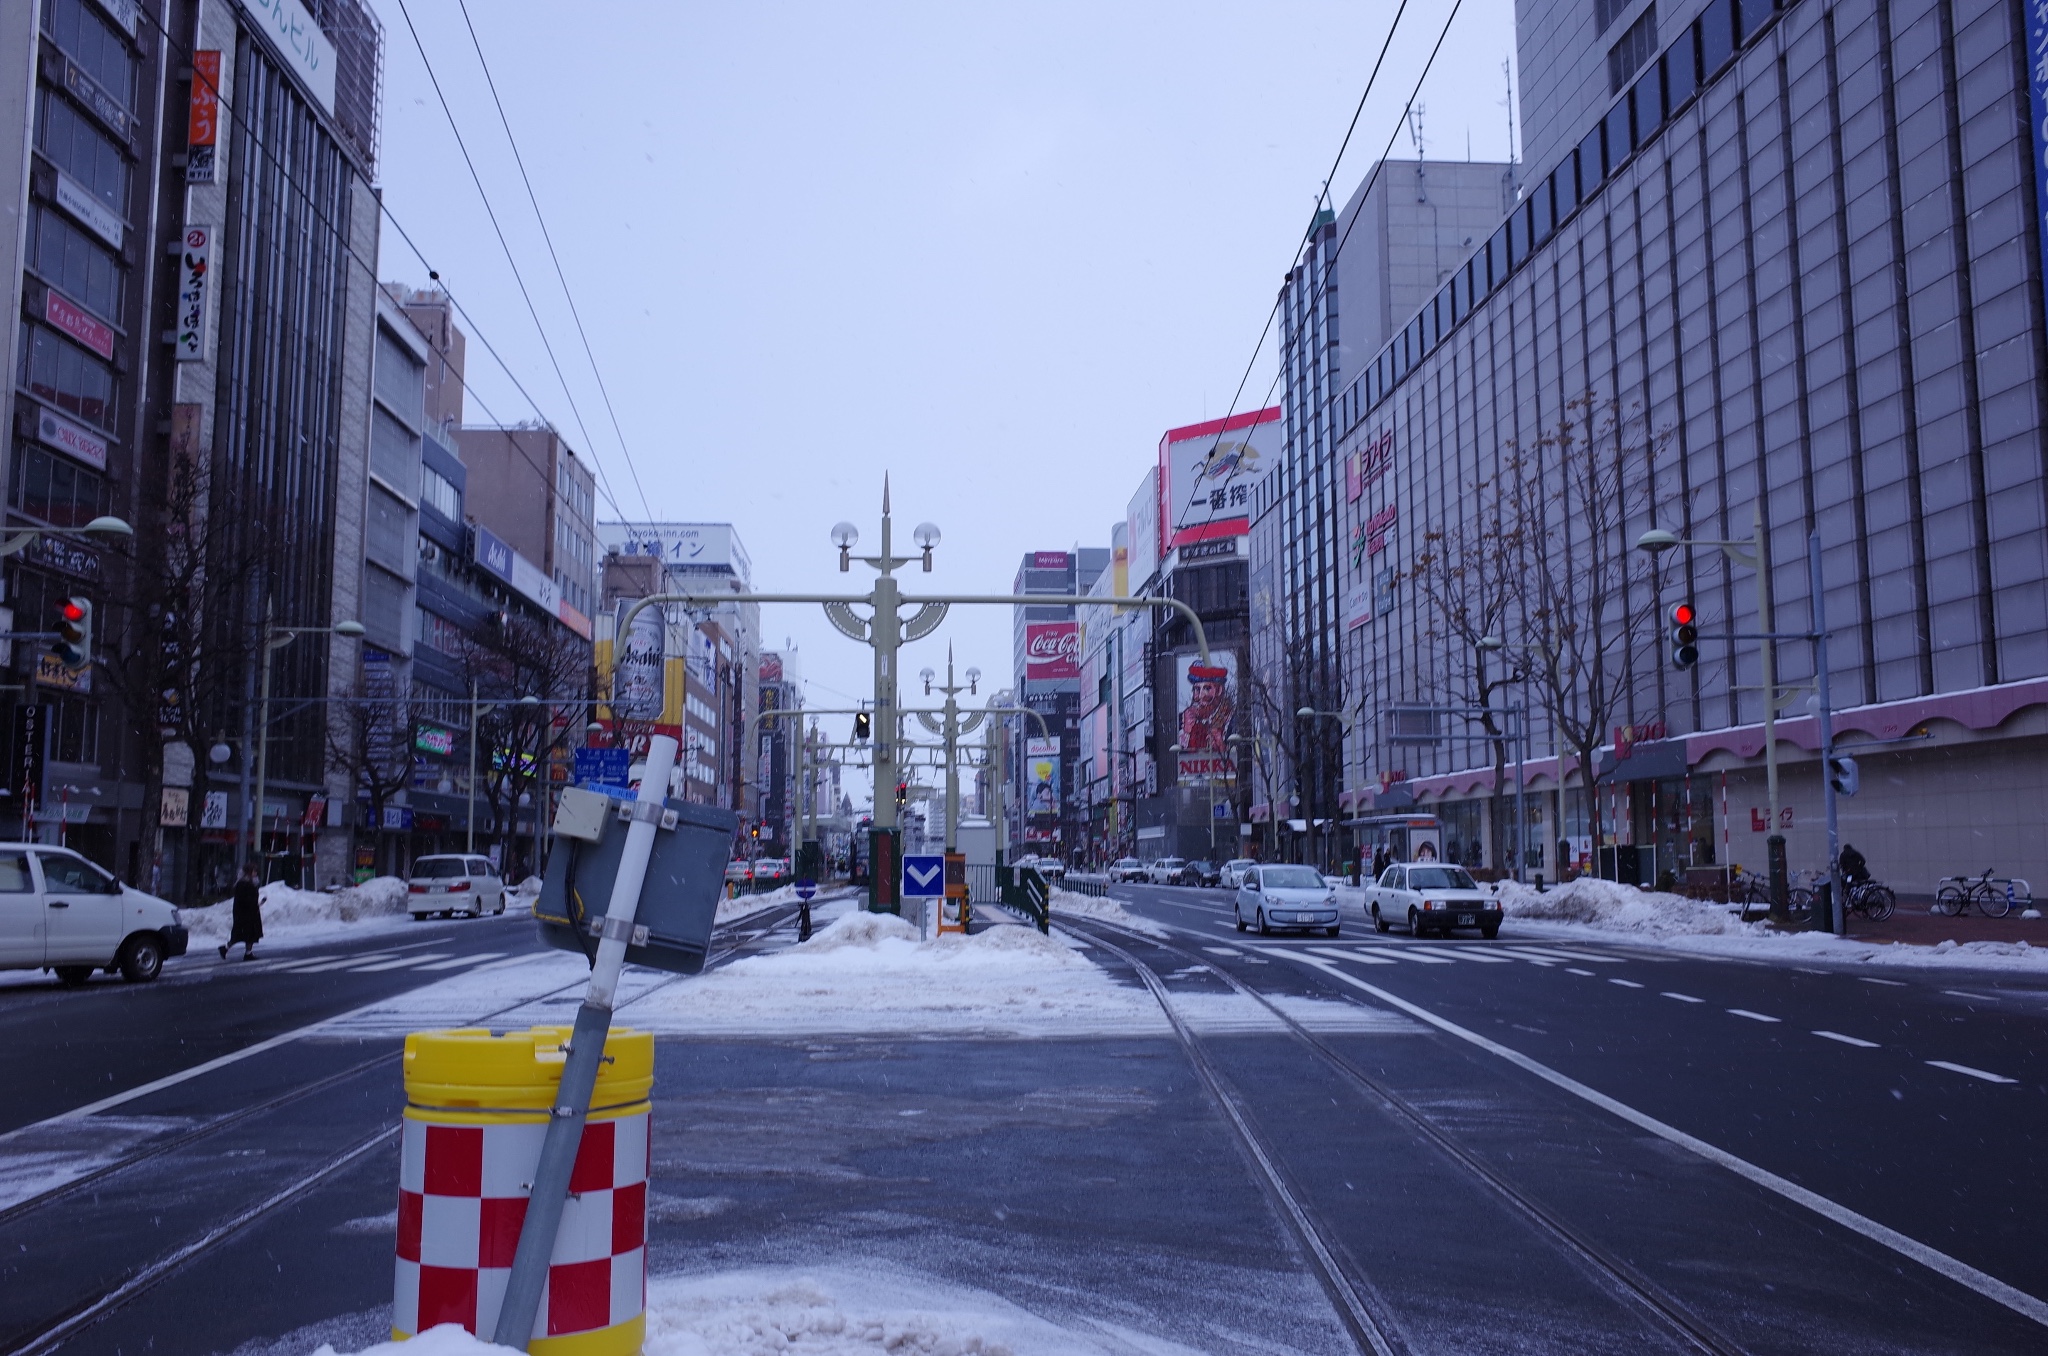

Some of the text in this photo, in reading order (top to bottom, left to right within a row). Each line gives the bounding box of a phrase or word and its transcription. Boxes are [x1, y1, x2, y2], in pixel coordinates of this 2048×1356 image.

[260, 0, 319, 71] んビル
[1362, 428, 1391, 475] ラフィラ
[1191, 483, 1254, 510] 一番搾
[1181, 541, 1236, 560] すすきのビル
[1030, 744, 1057, 753] docomo
[1179, 758, 1236, 775] NIKKA
